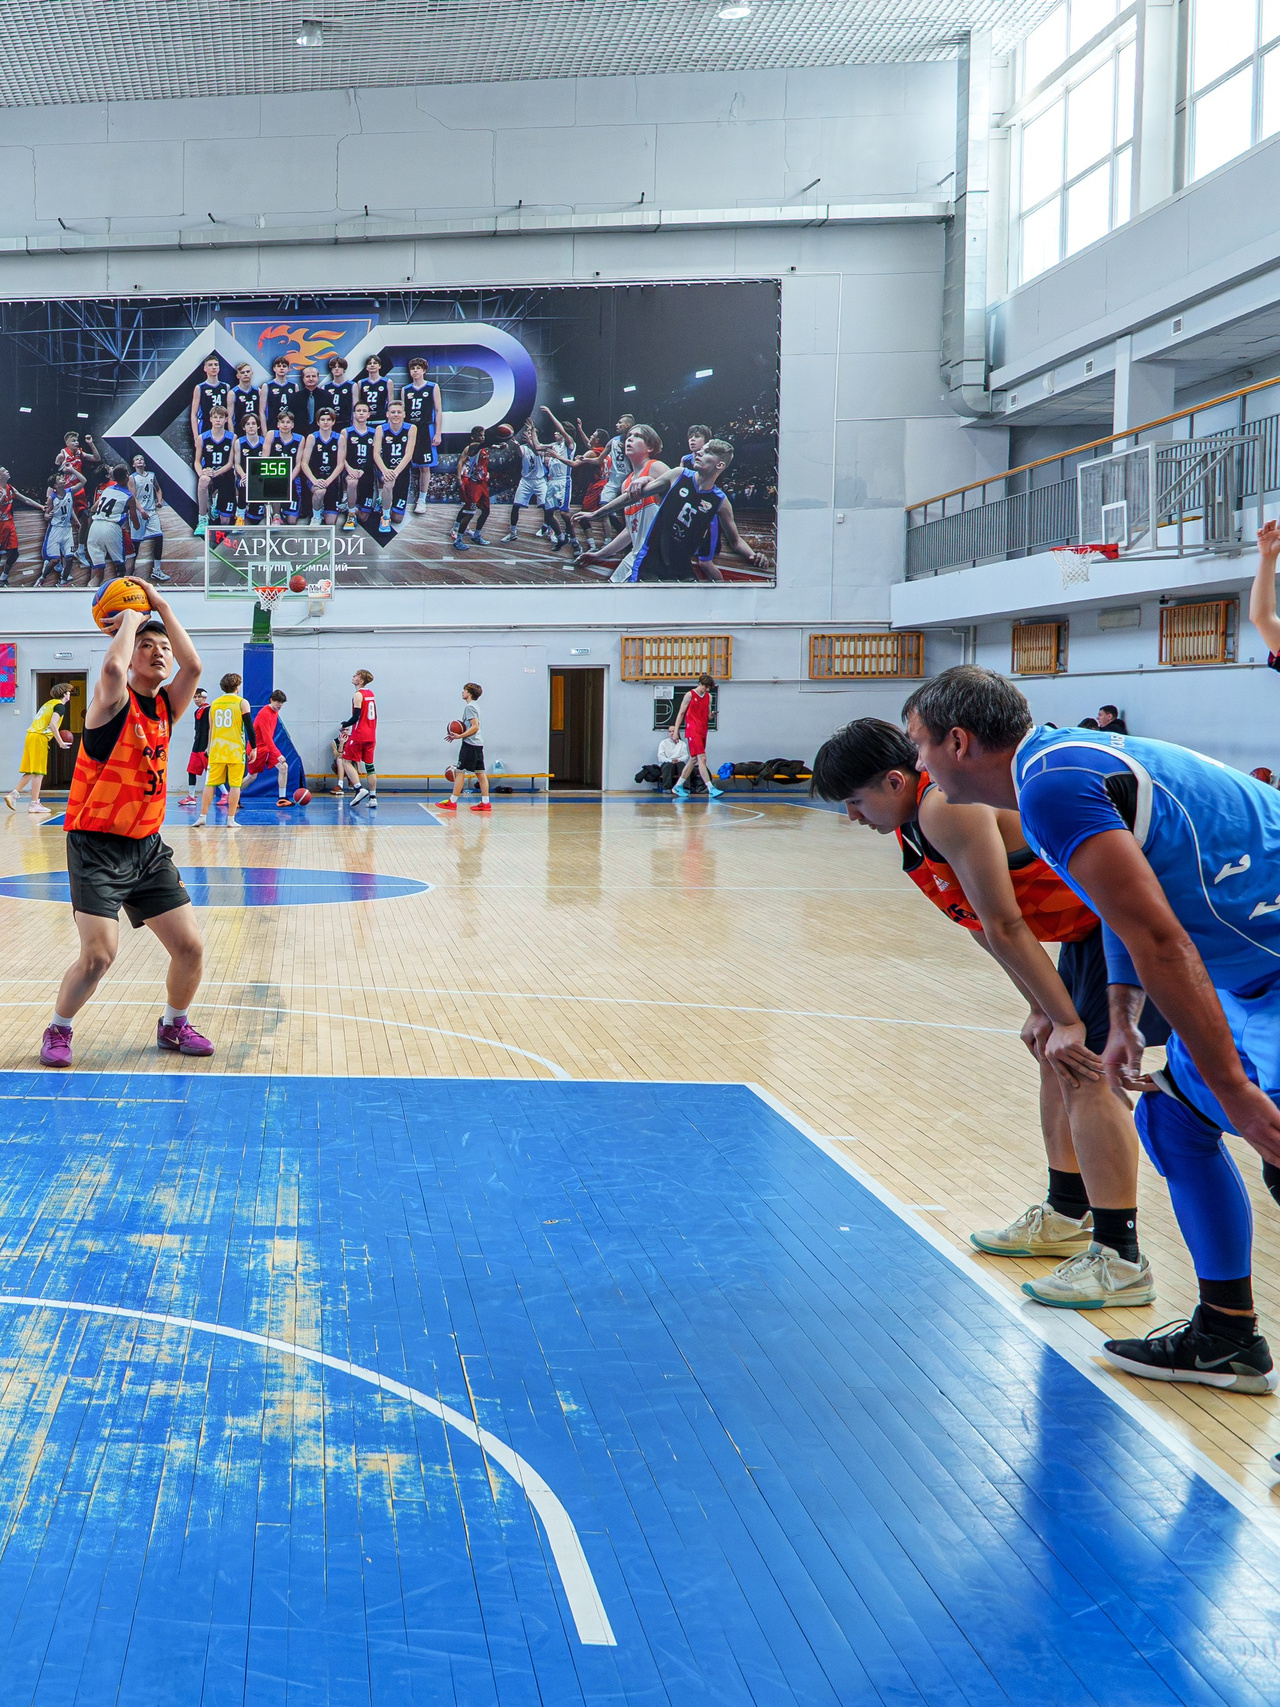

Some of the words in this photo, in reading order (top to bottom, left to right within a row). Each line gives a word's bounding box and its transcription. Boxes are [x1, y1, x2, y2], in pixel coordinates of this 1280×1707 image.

[211, 394, 222, 407] 34
[280, 394, 287, 404] 4
[367, 391, 378, 403] 22
[245, 401, 254, 412] 23
[411, 398, 422, 409] 15
[357, 444, 367, 457] 19
[391, 444, 402, 456] 12
[212, 452, 222, 464] 13
[322, 452, 328, 464] 5
[423, 453, 432, 462] 15
[226, 502, 234, 512] 13
[364, 497, 373, 507] 19
[396, 499, 406, 509] 12
[233, 534, 366, 556] АРХСТРОЙ
[215, 708, 233, 728] 68
